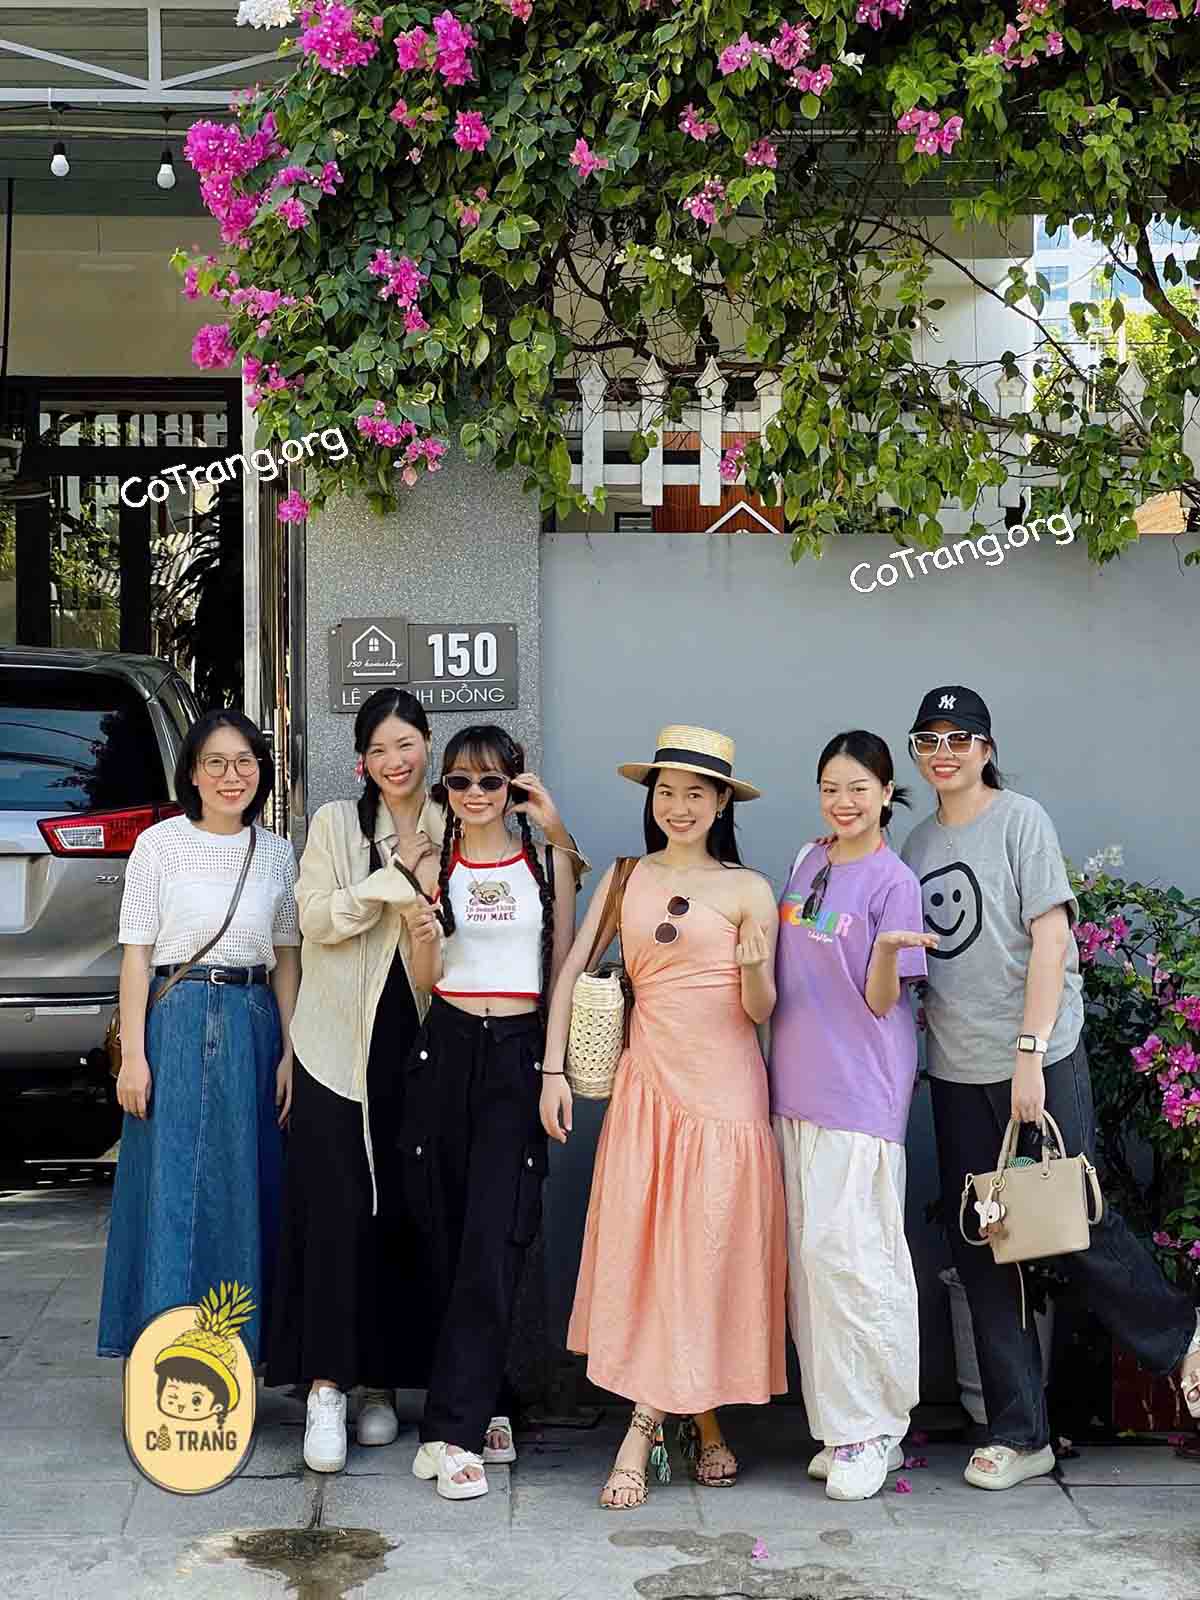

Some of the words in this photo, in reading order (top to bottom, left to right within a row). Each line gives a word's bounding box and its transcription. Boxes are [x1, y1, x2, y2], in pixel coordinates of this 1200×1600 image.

[427, 631, 498, 677] 150
[342, 687, 361, 706] LÊ
[466, 913, 487, 922] YOU
